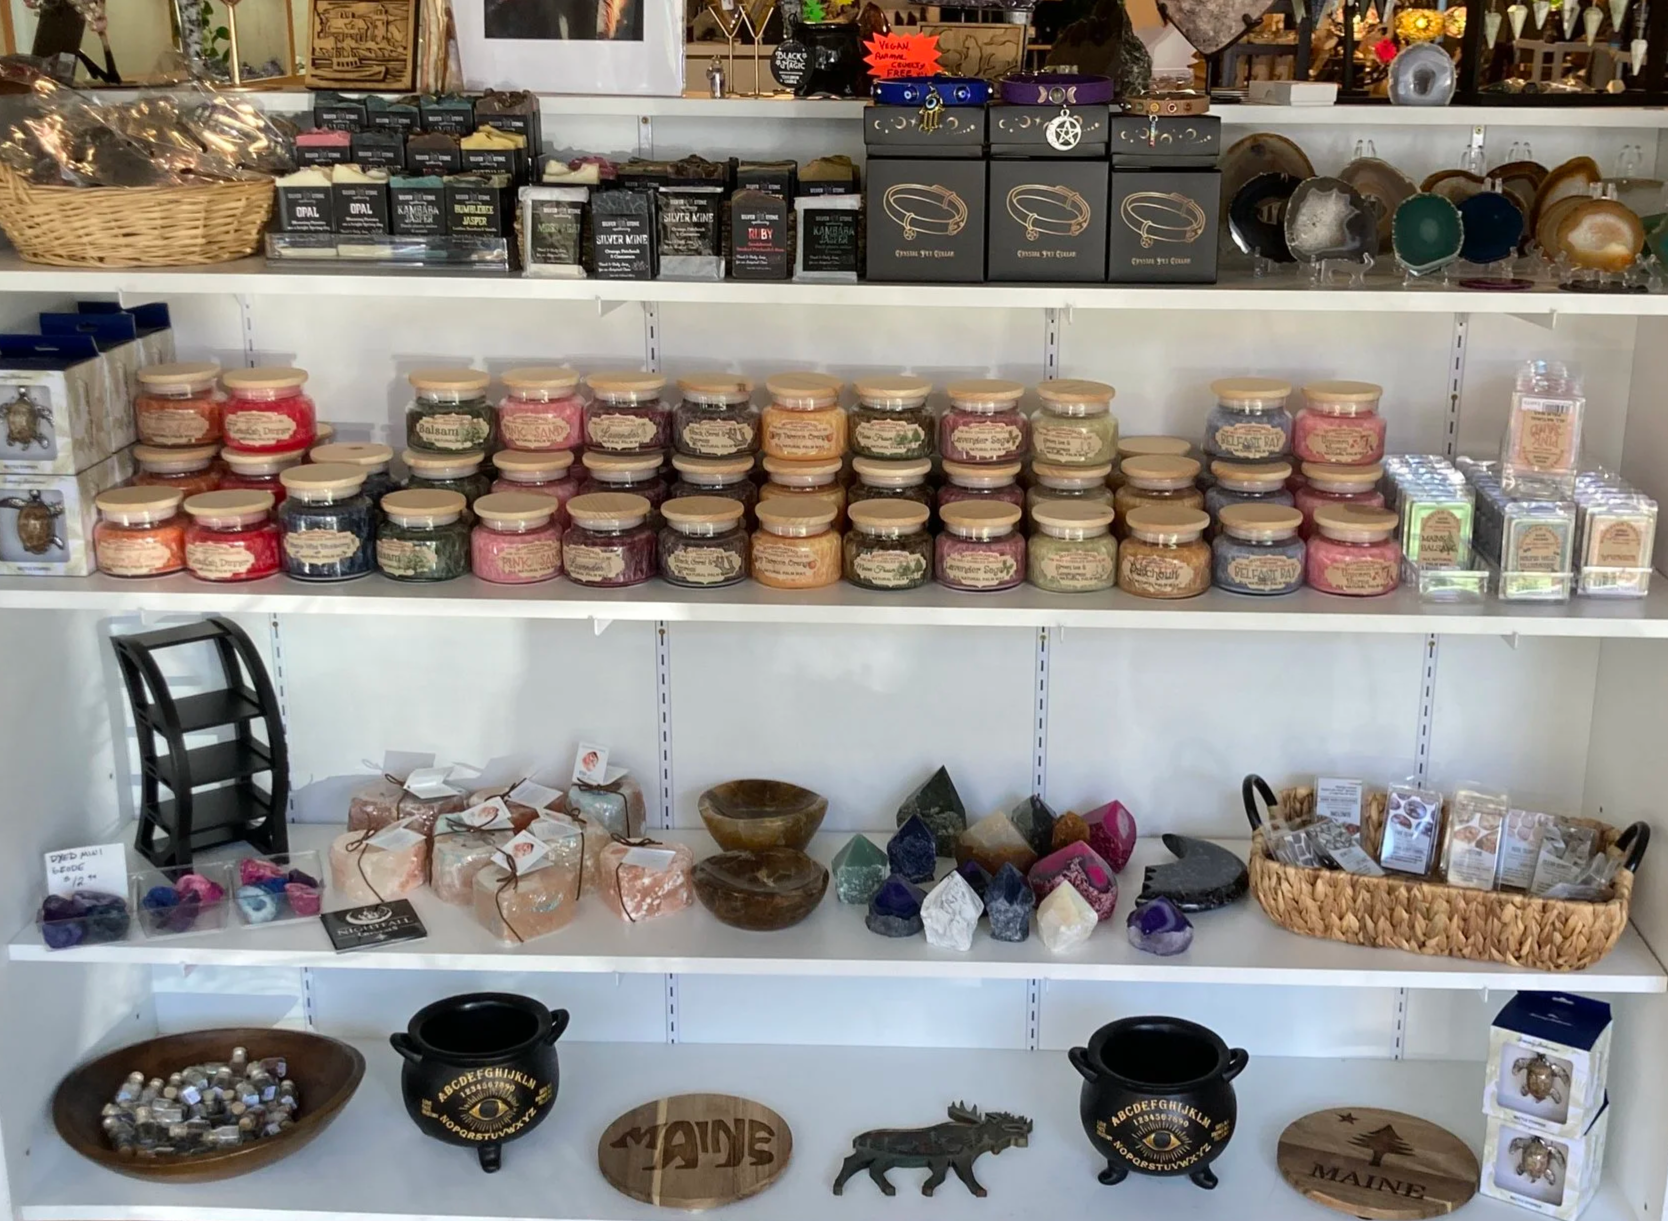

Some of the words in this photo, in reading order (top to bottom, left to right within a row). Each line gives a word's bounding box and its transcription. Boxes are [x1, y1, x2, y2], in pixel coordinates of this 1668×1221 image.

[775, 51, 804, 62] BLACK
[780, 60, 805, 70] MAGIC
[887, 69, 912, 77] FREE
[296, 206, 319, 218] OPAL
[350, 203, 372, 214] OPAL
[454, 204, 494, 214] BUMBLEBEE
[462, 216, 487, 226] JASPER
[664, 213, 690, 222] SILVER
[692, 213, 714, 222] MINE
[596, 234, 623, 245] SILVER
[625, 234, 648, 245] MINE
[748, 228, 773, 240] RUBY
[419, 423, 458, 436] Balsam
[533, 424, 564, 438] SAND
[953, 434, 988, 445] Lavender
[1264, 432, 1281, 446] BAY
[502, 556, 531, 569] PINK
[945, 562, 981, 574] Lavender
[1280, 565, 1298, 579] BAY
[337, 917, 409, 935] NIGHTFALL
[438, 1067, 537, 1103] ABCDEFGHIJKLM
[460, 1081, 516, 1098] 1234567890
[1111, 1099, 1211, 1129] ABCDEFGHIJKLM
[1133, 1113, 1190, 1128] 1234567890
[440, 1107, 537, 1141] NOPQRSTUVWXYZ
[609, 1118, 776, 1171] MAINE
[1113, 1142, 1212, 1171] NOPQRSTUVWXYZ
[1309, 1161, 1427, 1200] MAINE
